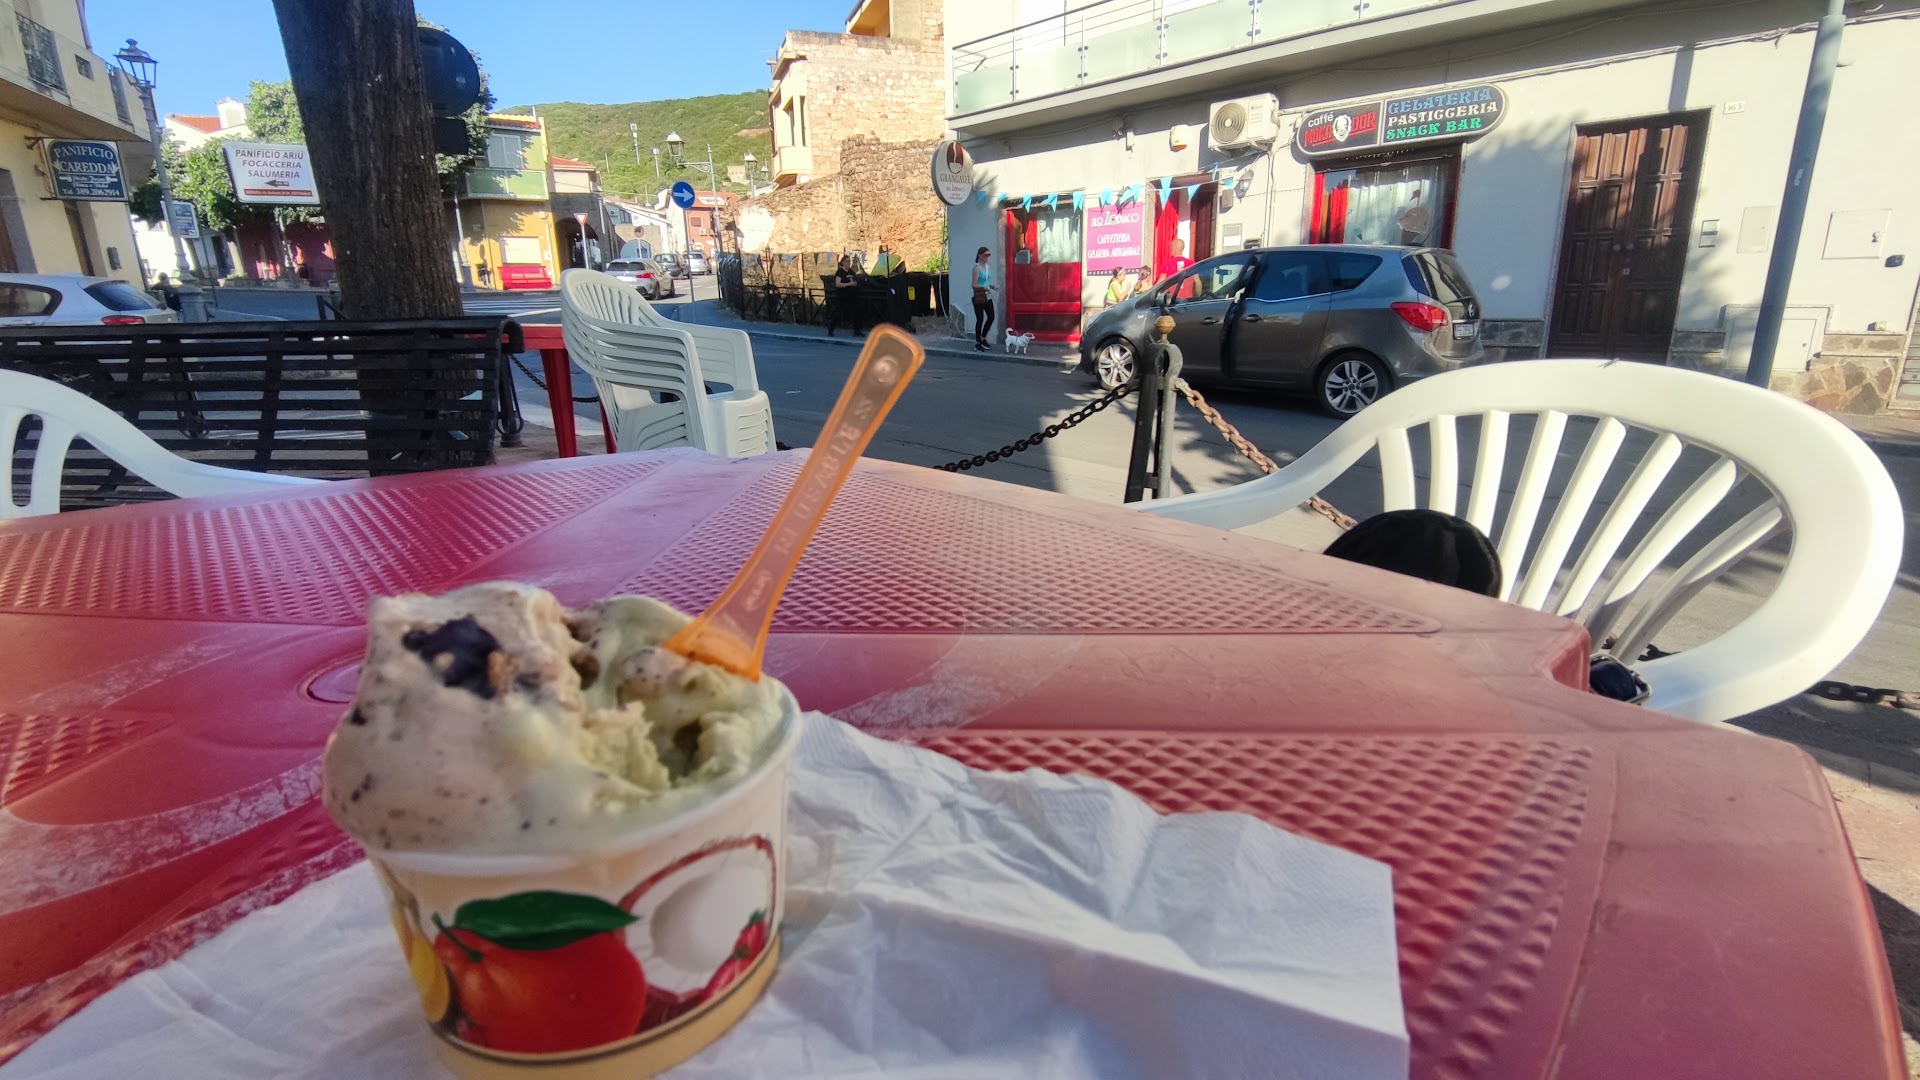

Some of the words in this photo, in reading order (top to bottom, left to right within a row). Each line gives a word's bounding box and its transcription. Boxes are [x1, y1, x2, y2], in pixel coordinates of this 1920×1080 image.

[1388, 87, 1492, 115] GELATERIA
[1727, 103, 1742, 111] 163
[1388, 101, 1498, 127] PASTICCERIA
[1386, 123, 1440, 140] SNACK
[1446, 117, 1482, 132] BAR
[53, 145, 114, 160] PANIFICIO
[235, 149, 280, 159] PANIFICIO
[282, 151, 303, 160] ARIU
[60, 161, 114, 174] CAREDDA
[242, 159, 302, 169] FOCACCERIA
[248, 170, 300, 179] SALUMERIA
[1104, 210, 1140, 226] ZODIACO
